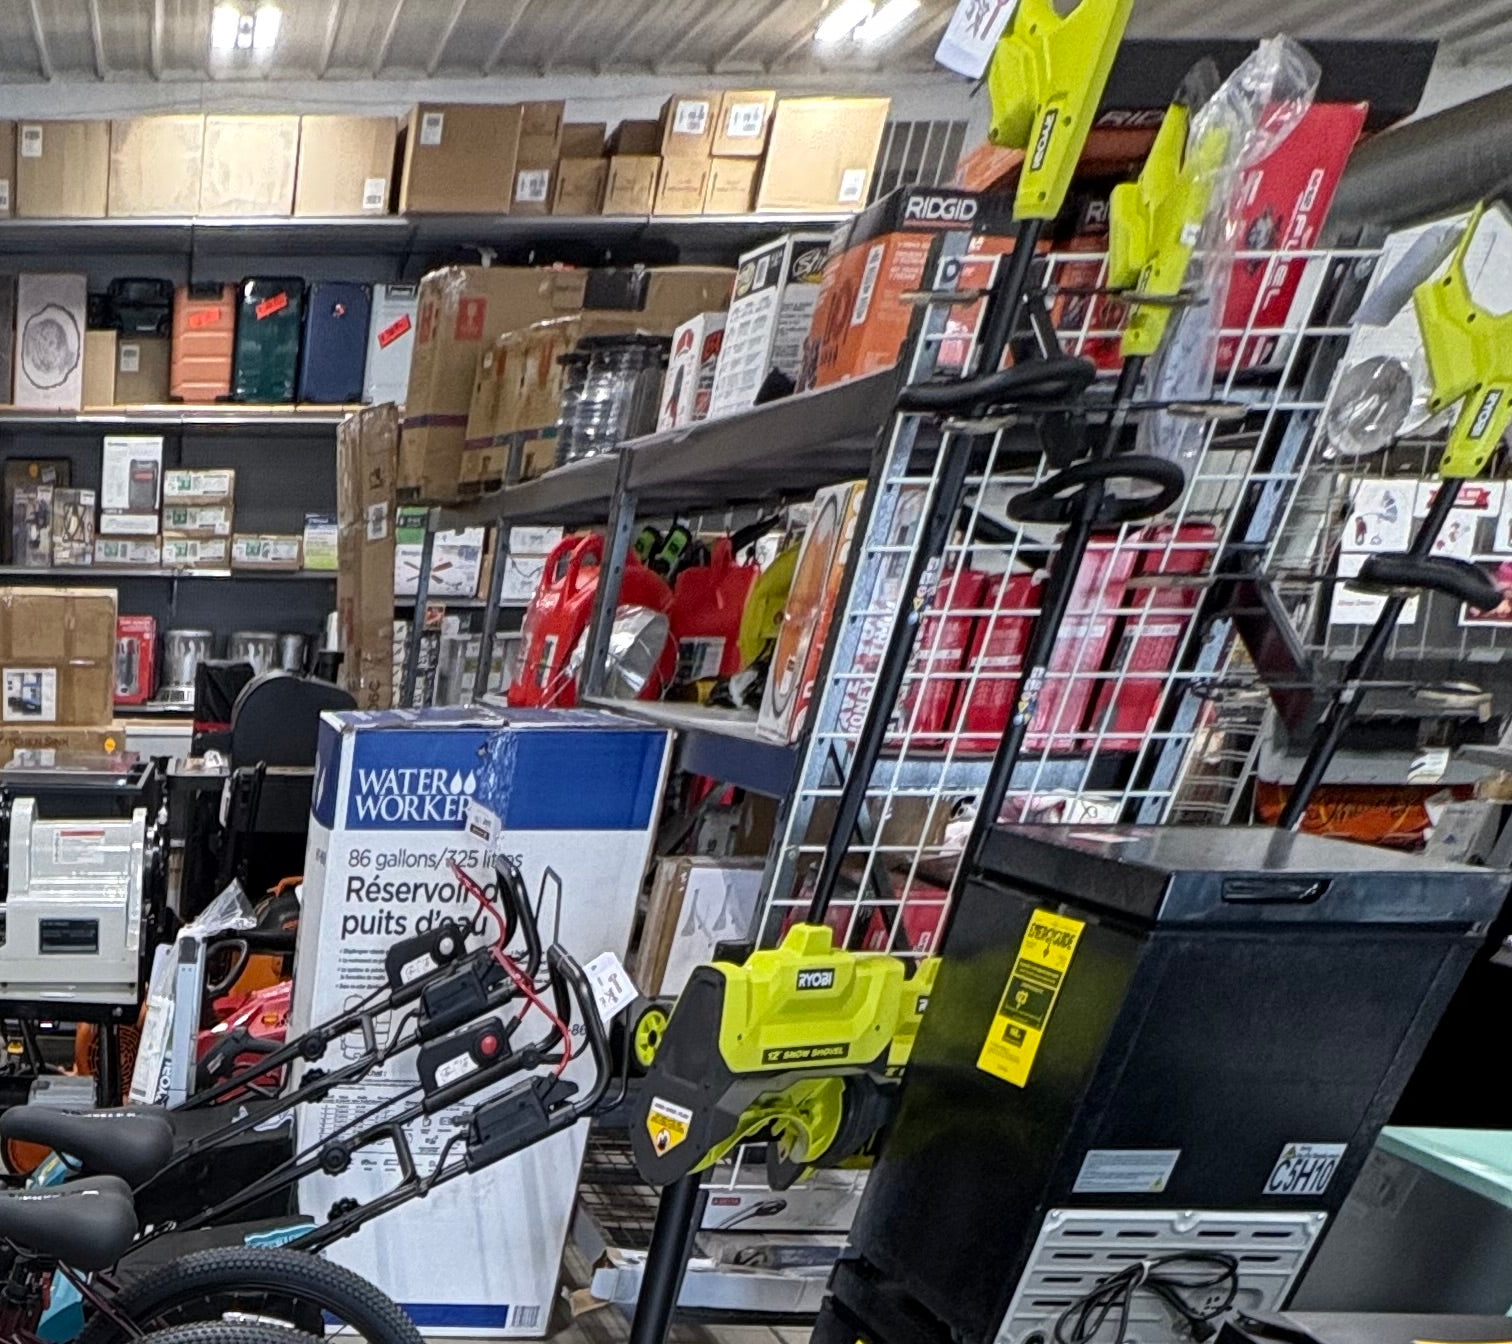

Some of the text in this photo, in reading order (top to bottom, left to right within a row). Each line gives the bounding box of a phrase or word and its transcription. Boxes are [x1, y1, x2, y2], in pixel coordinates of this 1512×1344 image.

[904, 195, 978, 221] RIDGID
[358, 767, 449, 795] WATER
[356, 794, 473, 822] WORKER
[348, 848, 371, 868] 86
[340, 909, 407, 940] puits
[797, 970, 833, 988] RYOBI
[1268, 1158, 1336, 1192] C5H10
